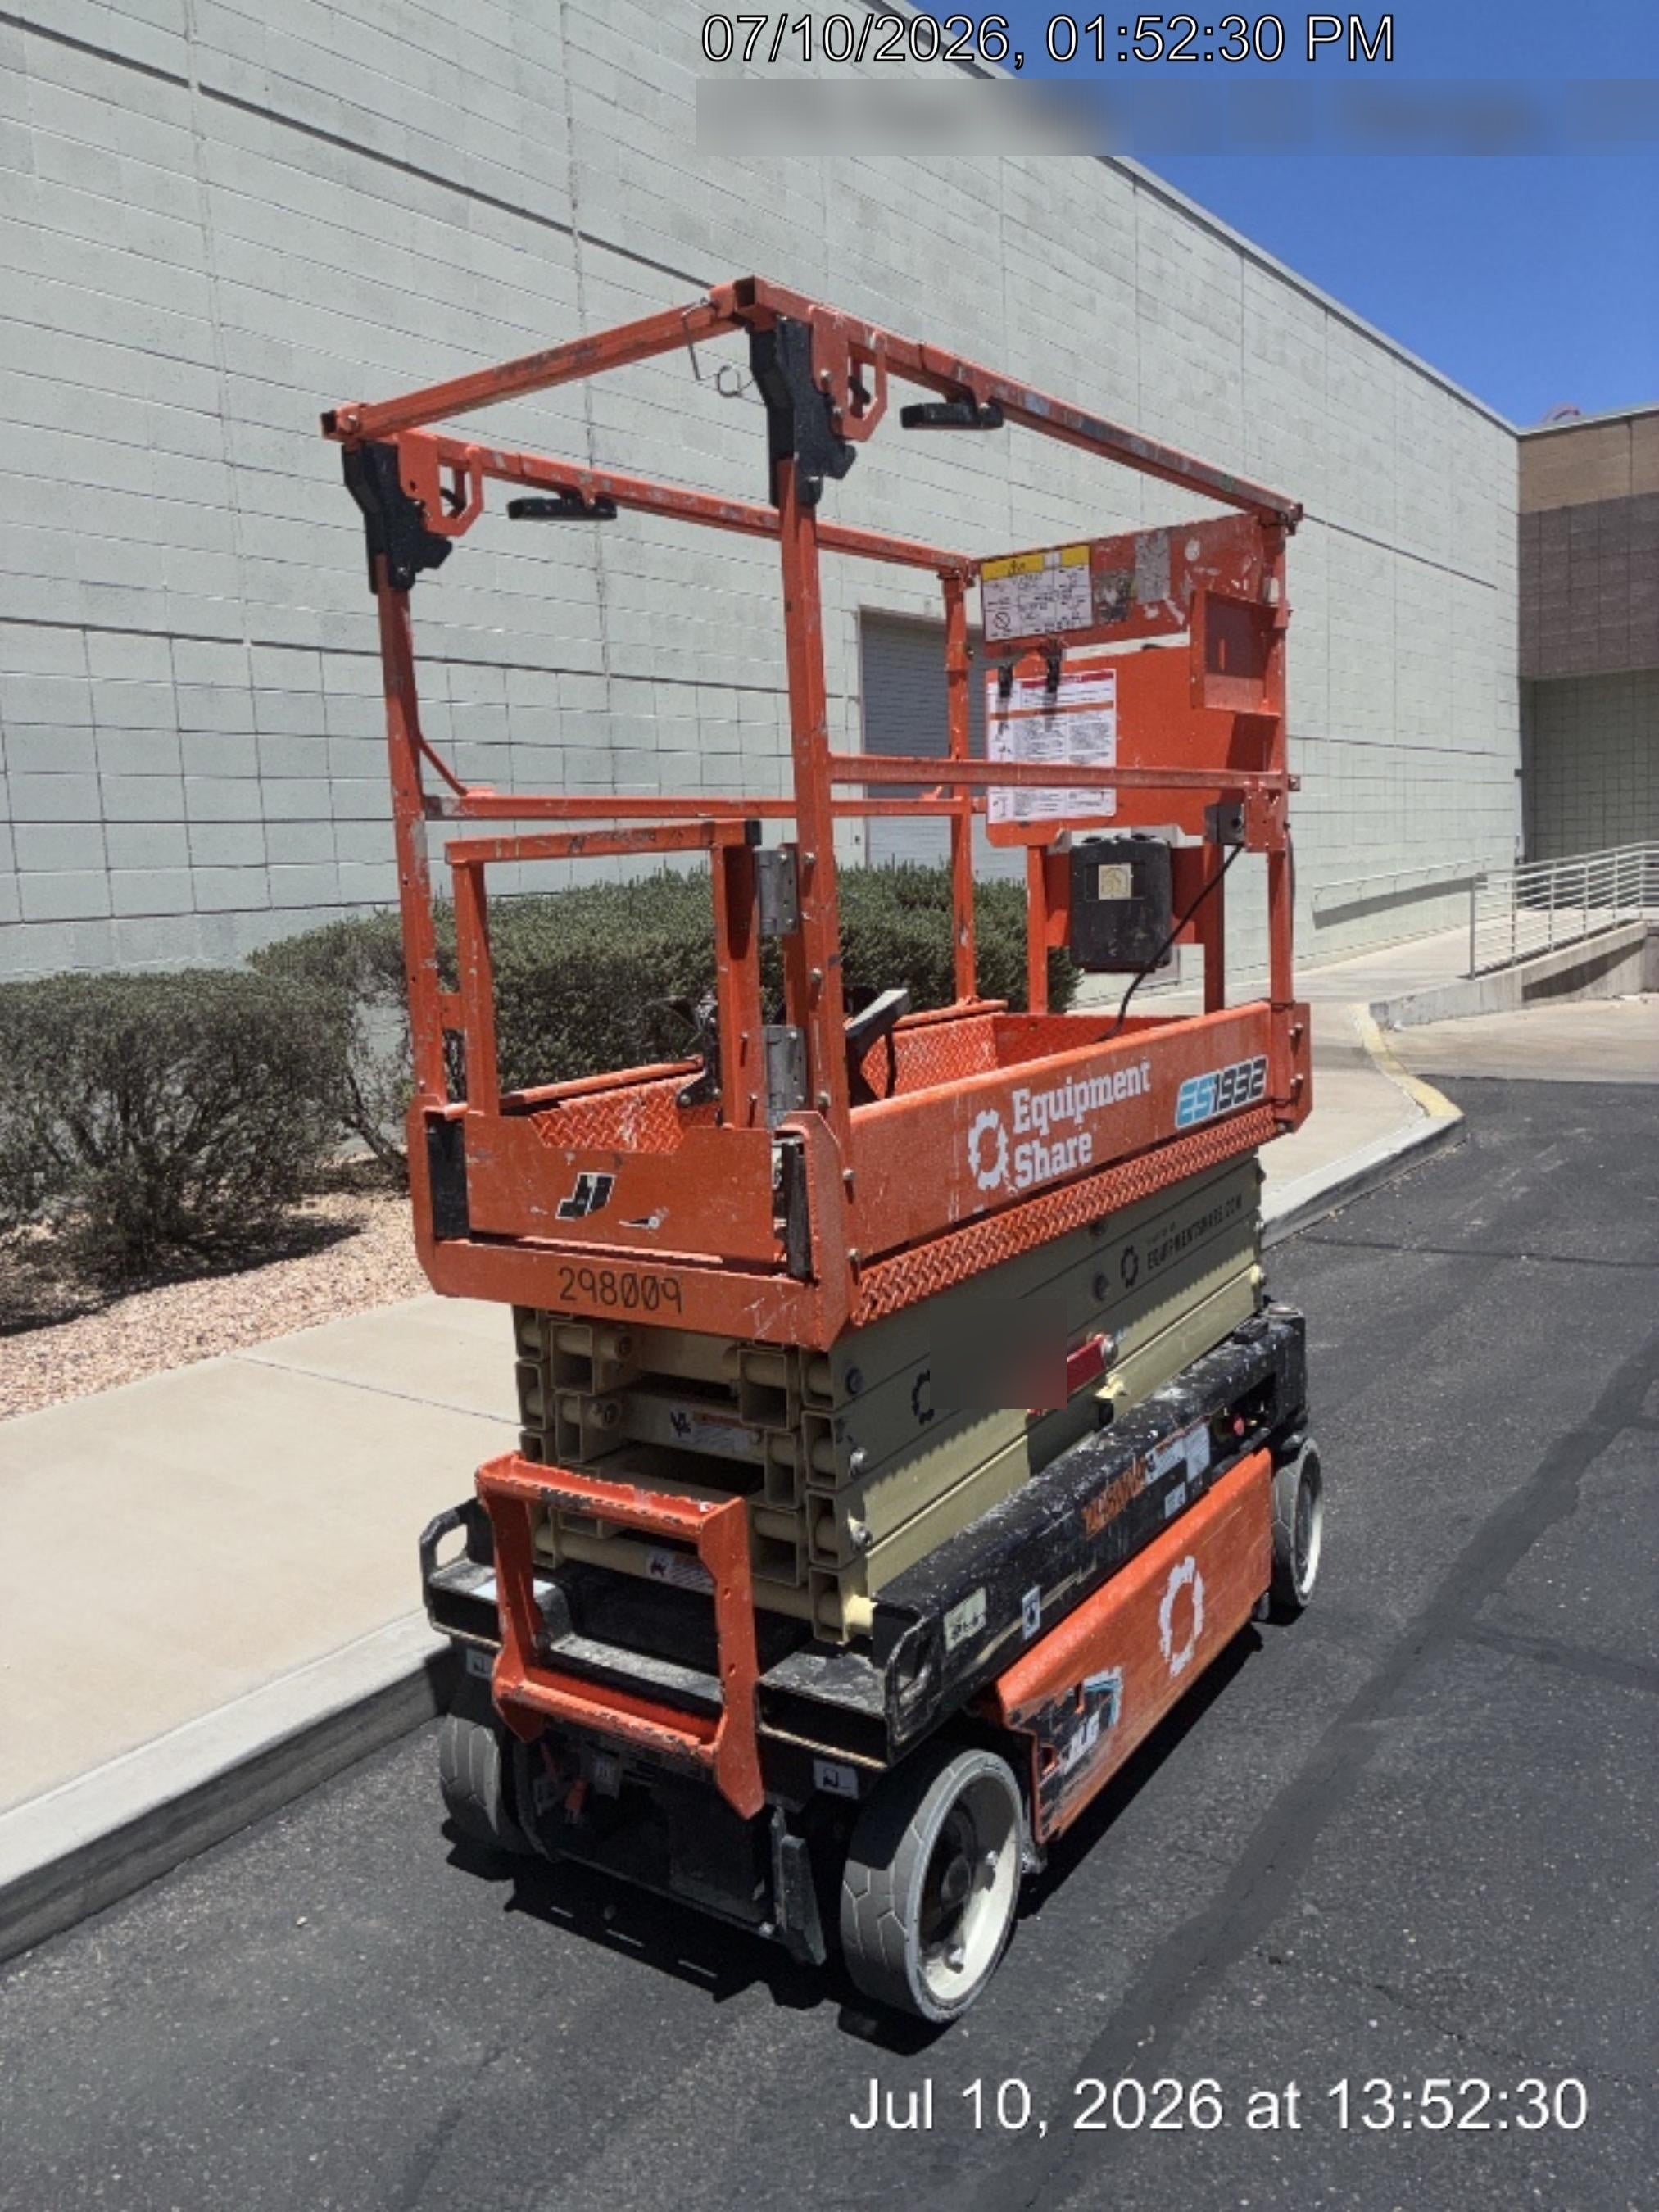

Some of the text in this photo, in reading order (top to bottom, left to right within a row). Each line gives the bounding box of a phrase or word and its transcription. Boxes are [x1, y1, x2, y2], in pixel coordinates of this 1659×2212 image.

[1013, 1057, 1151, 1136] Equipment
[1175, 1055, 1267, 1129] ES1932
[1014, 1132, 1094, 1189] Share
[559, 1267, 683, 1315] 298009
